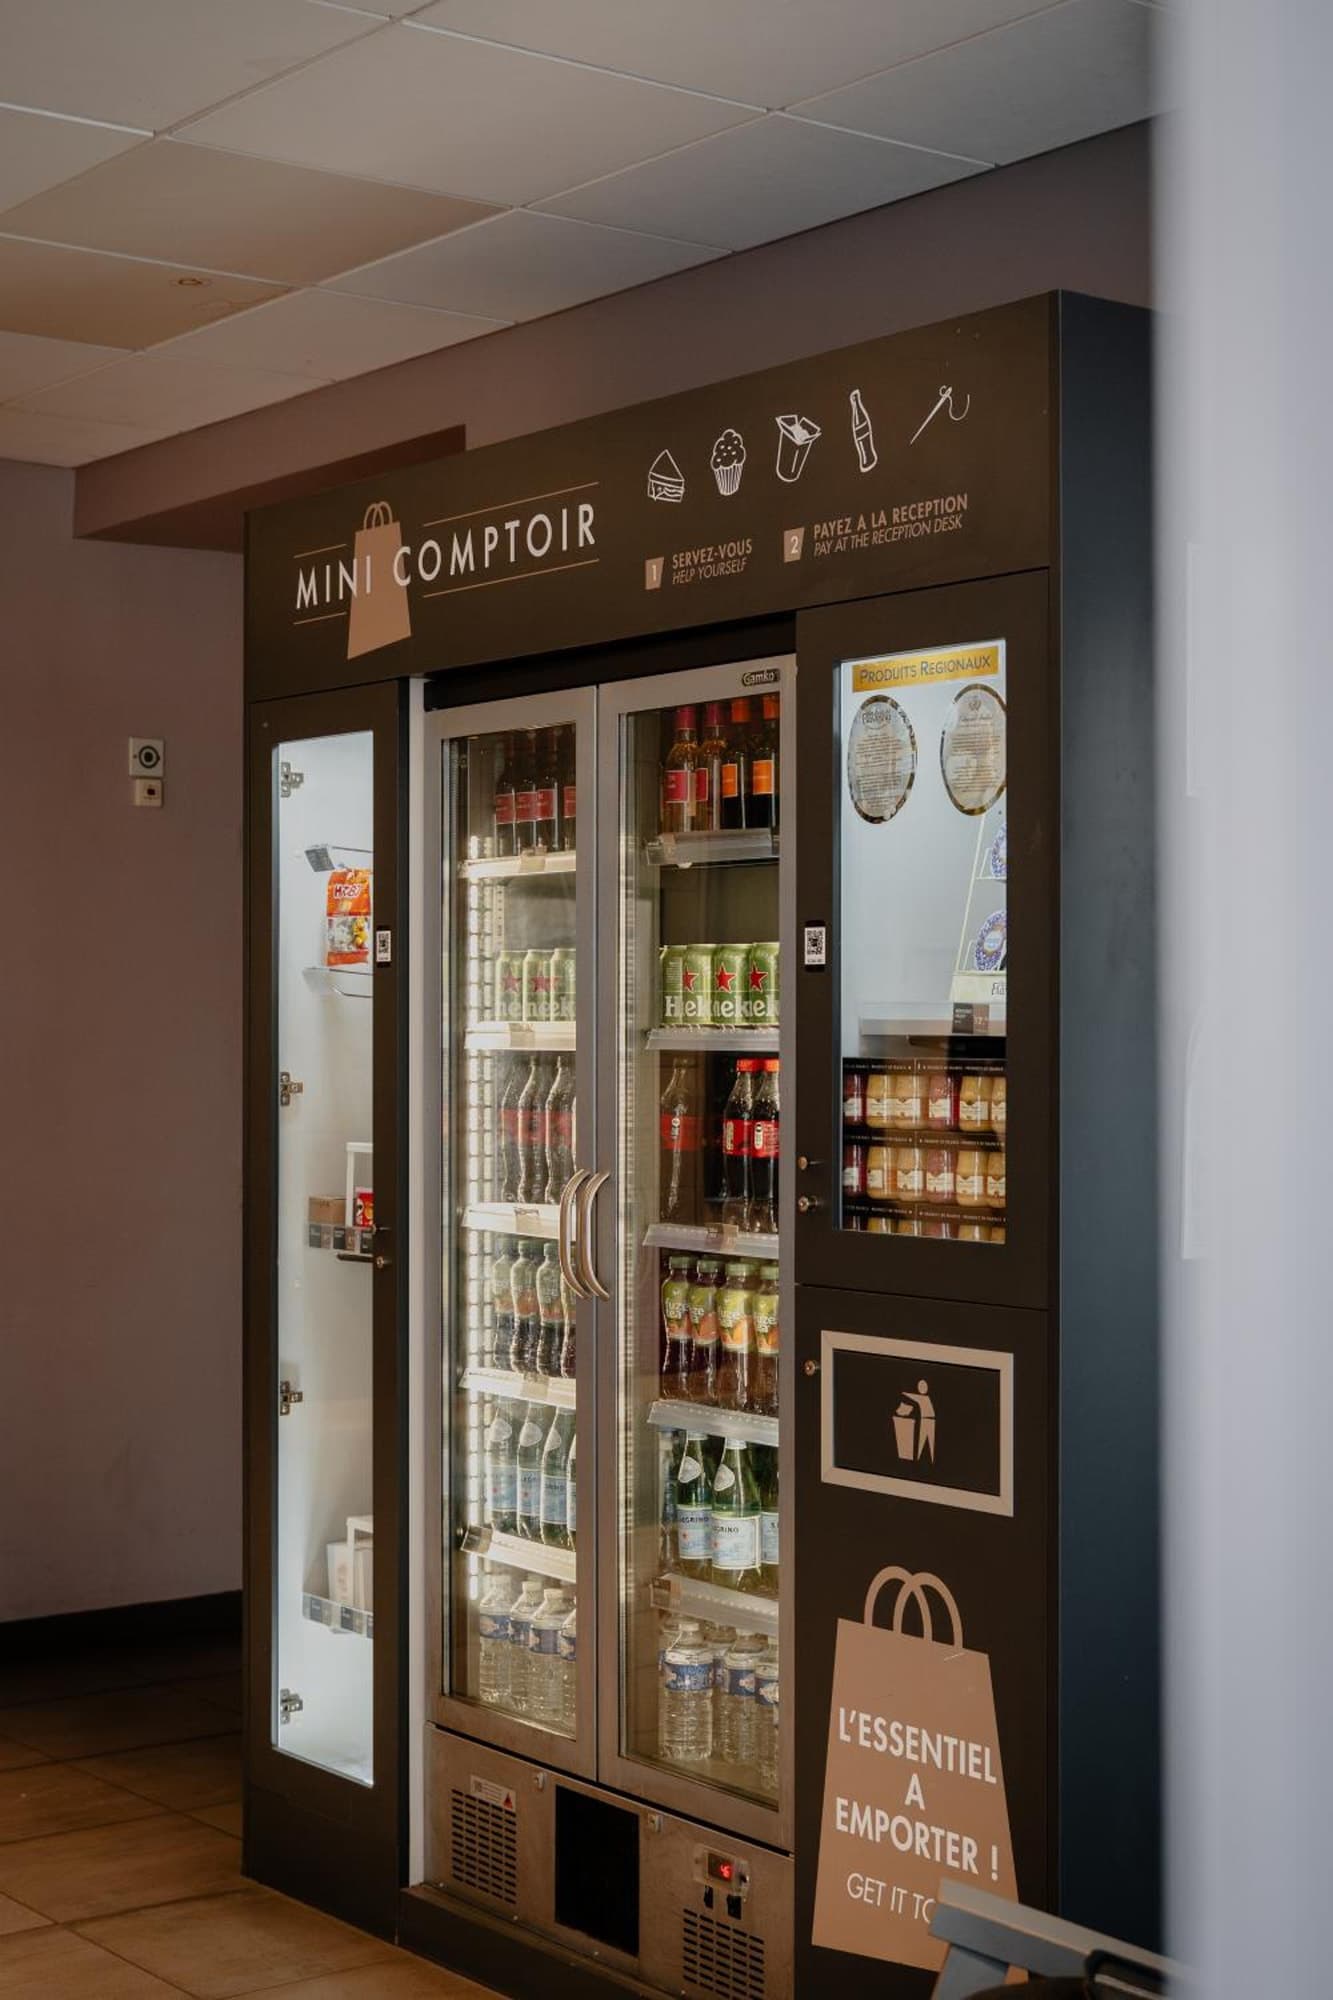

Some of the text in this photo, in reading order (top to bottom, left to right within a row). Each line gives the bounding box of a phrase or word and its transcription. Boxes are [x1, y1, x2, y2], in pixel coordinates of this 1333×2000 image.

[814, 493, 968, 540] PAYEZ A LA RECEPTION
[814, 514, 963, 557] PAY AT THE RECEPTION DESK
[296, 503, 596, 610] MINI COMPTOIR
[672, 538, 753, 570] SERVEZ-VOUS
[790, 535, 799, 554] 2
[651, 564, 657, 581] 1
[672, 557, 747, 585] HELP YOURSELF
[839, 1707, 997, 1784] L'ESSENTIEL
[904, 1773, 926, 1810] A
[836, 1796, 999, 1881] EMPORTER !
[847, 1872, 886, 1907] GET
[890, 1886, 908, 1914] IT
